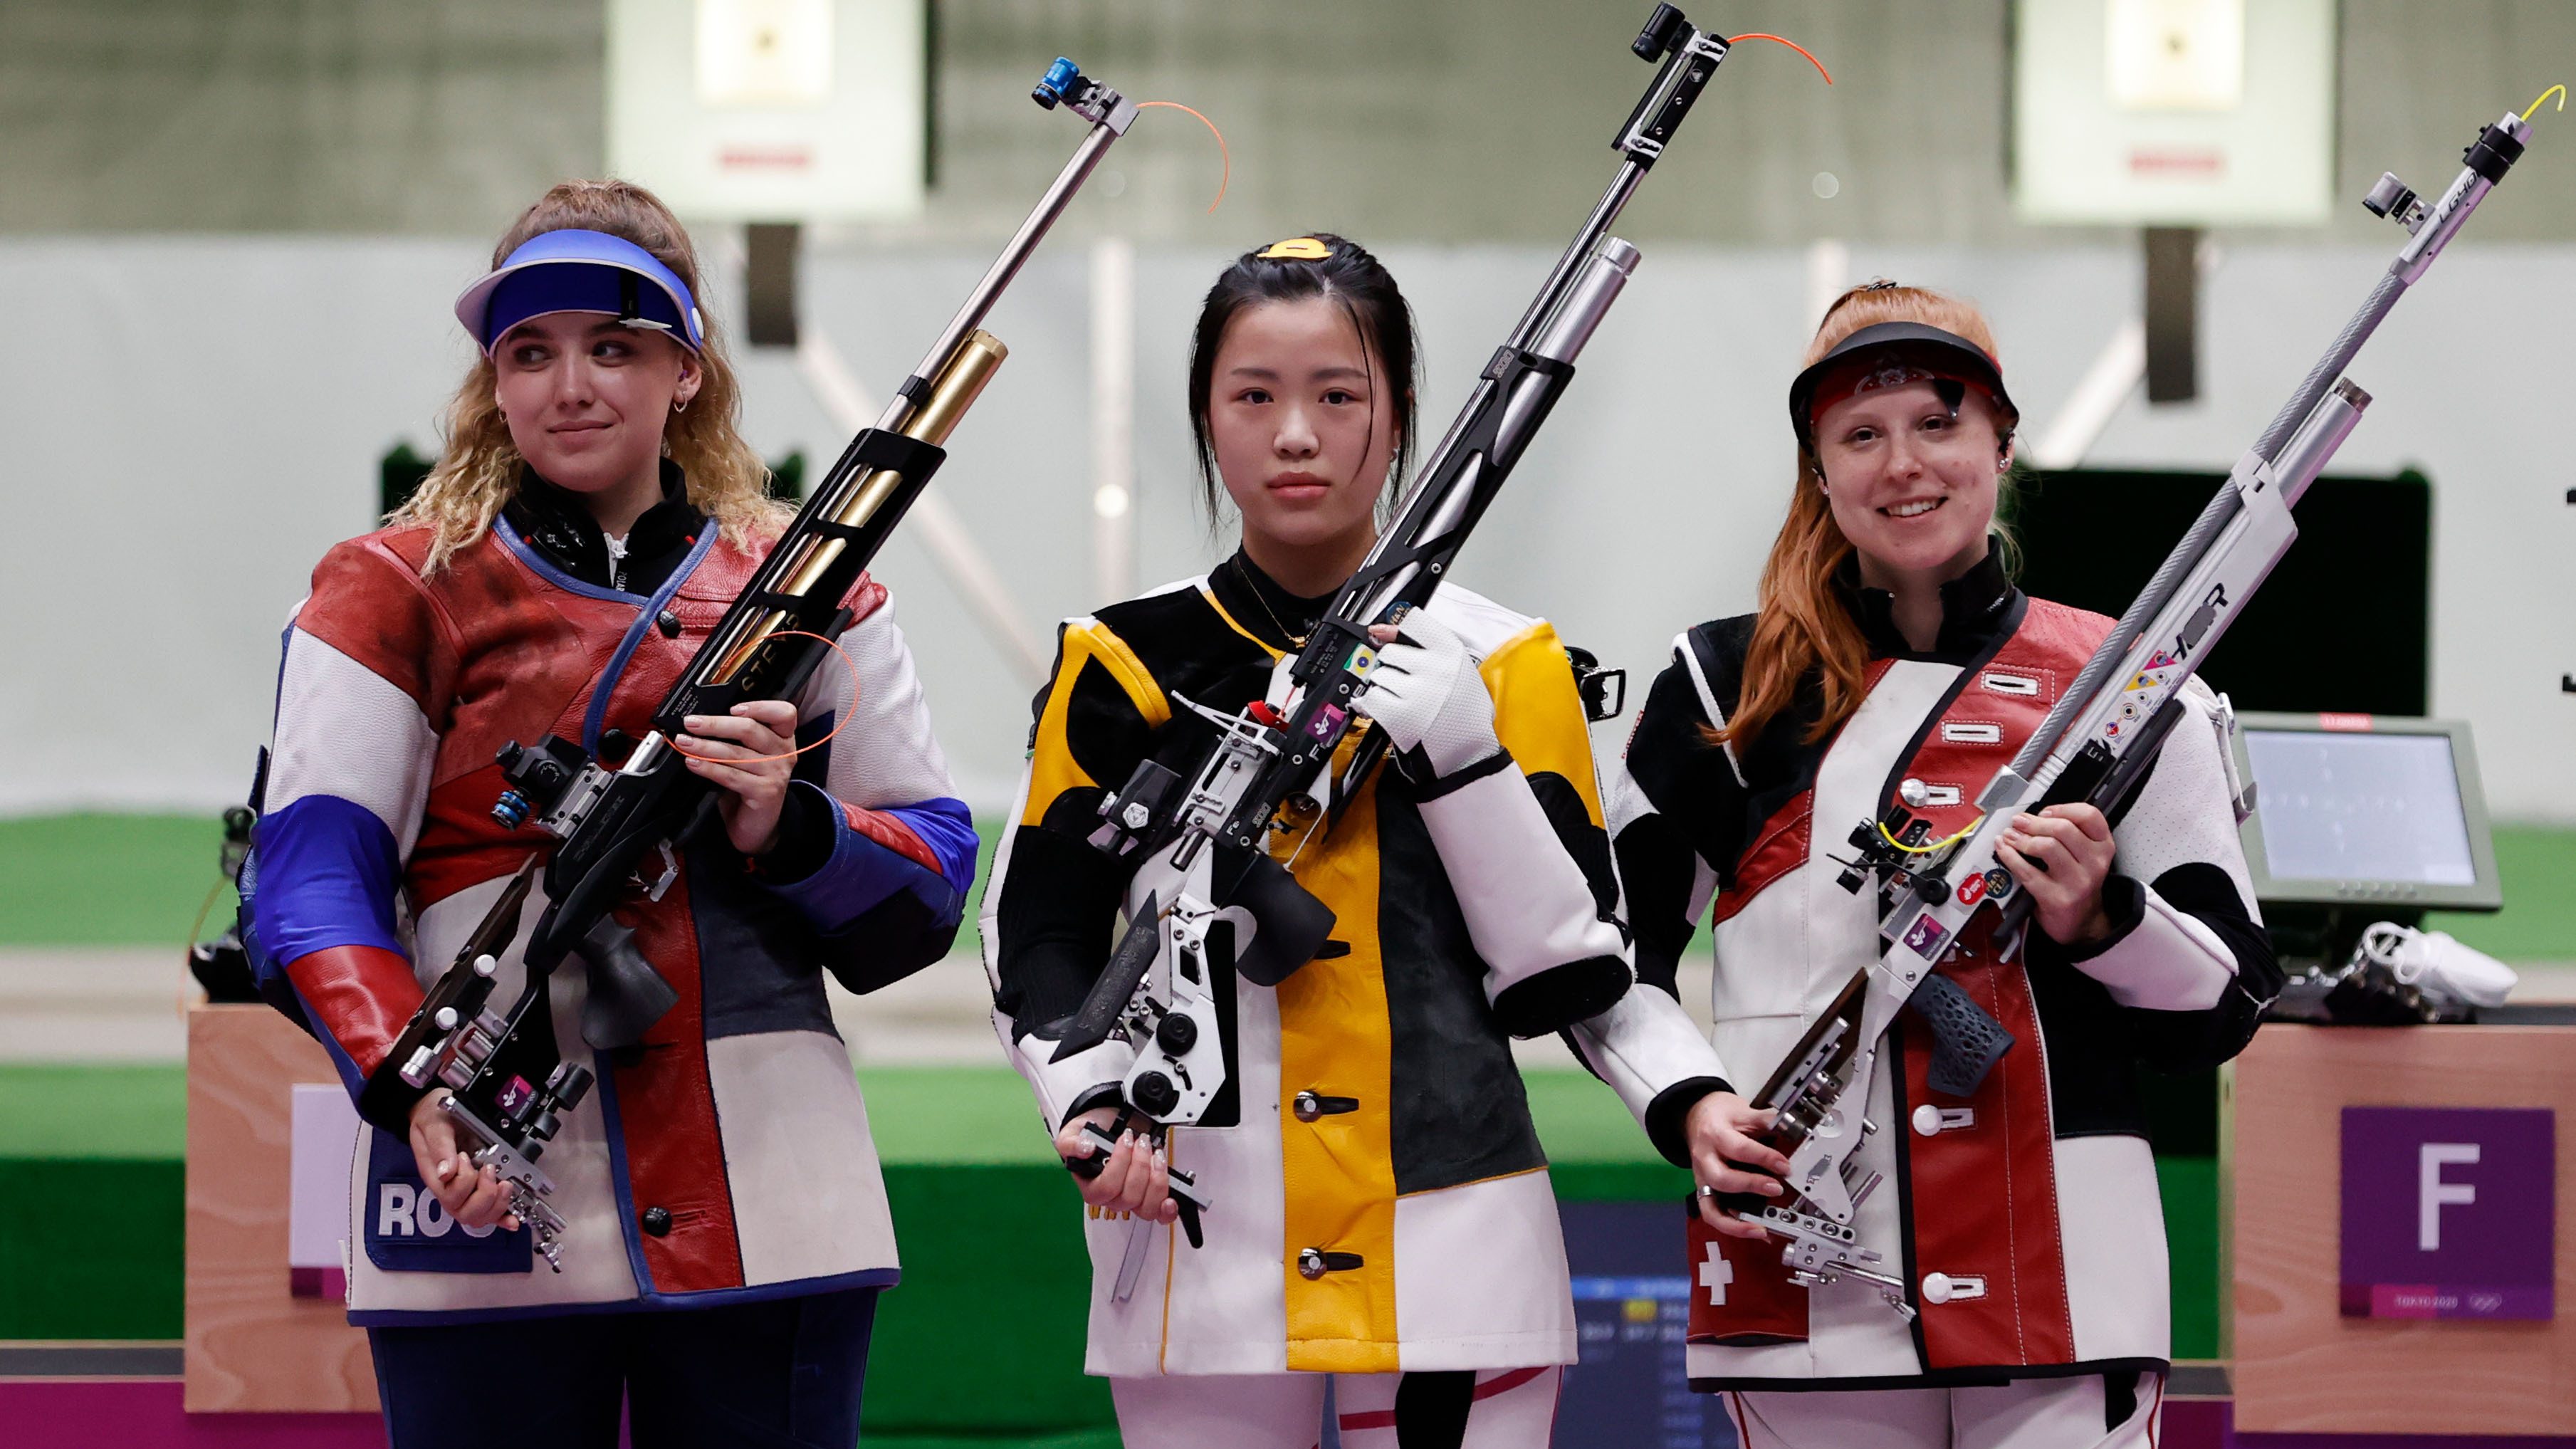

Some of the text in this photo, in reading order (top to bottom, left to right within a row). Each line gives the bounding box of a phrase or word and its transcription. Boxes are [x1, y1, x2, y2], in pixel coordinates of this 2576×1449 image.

[2439, 169, 2483, 223] LG40
[378, 1183, 497, 1238] RO
[2418, 1142, 2481, 1252] F
[2394, 1295, 2459, 1307] TOKYO 2020
